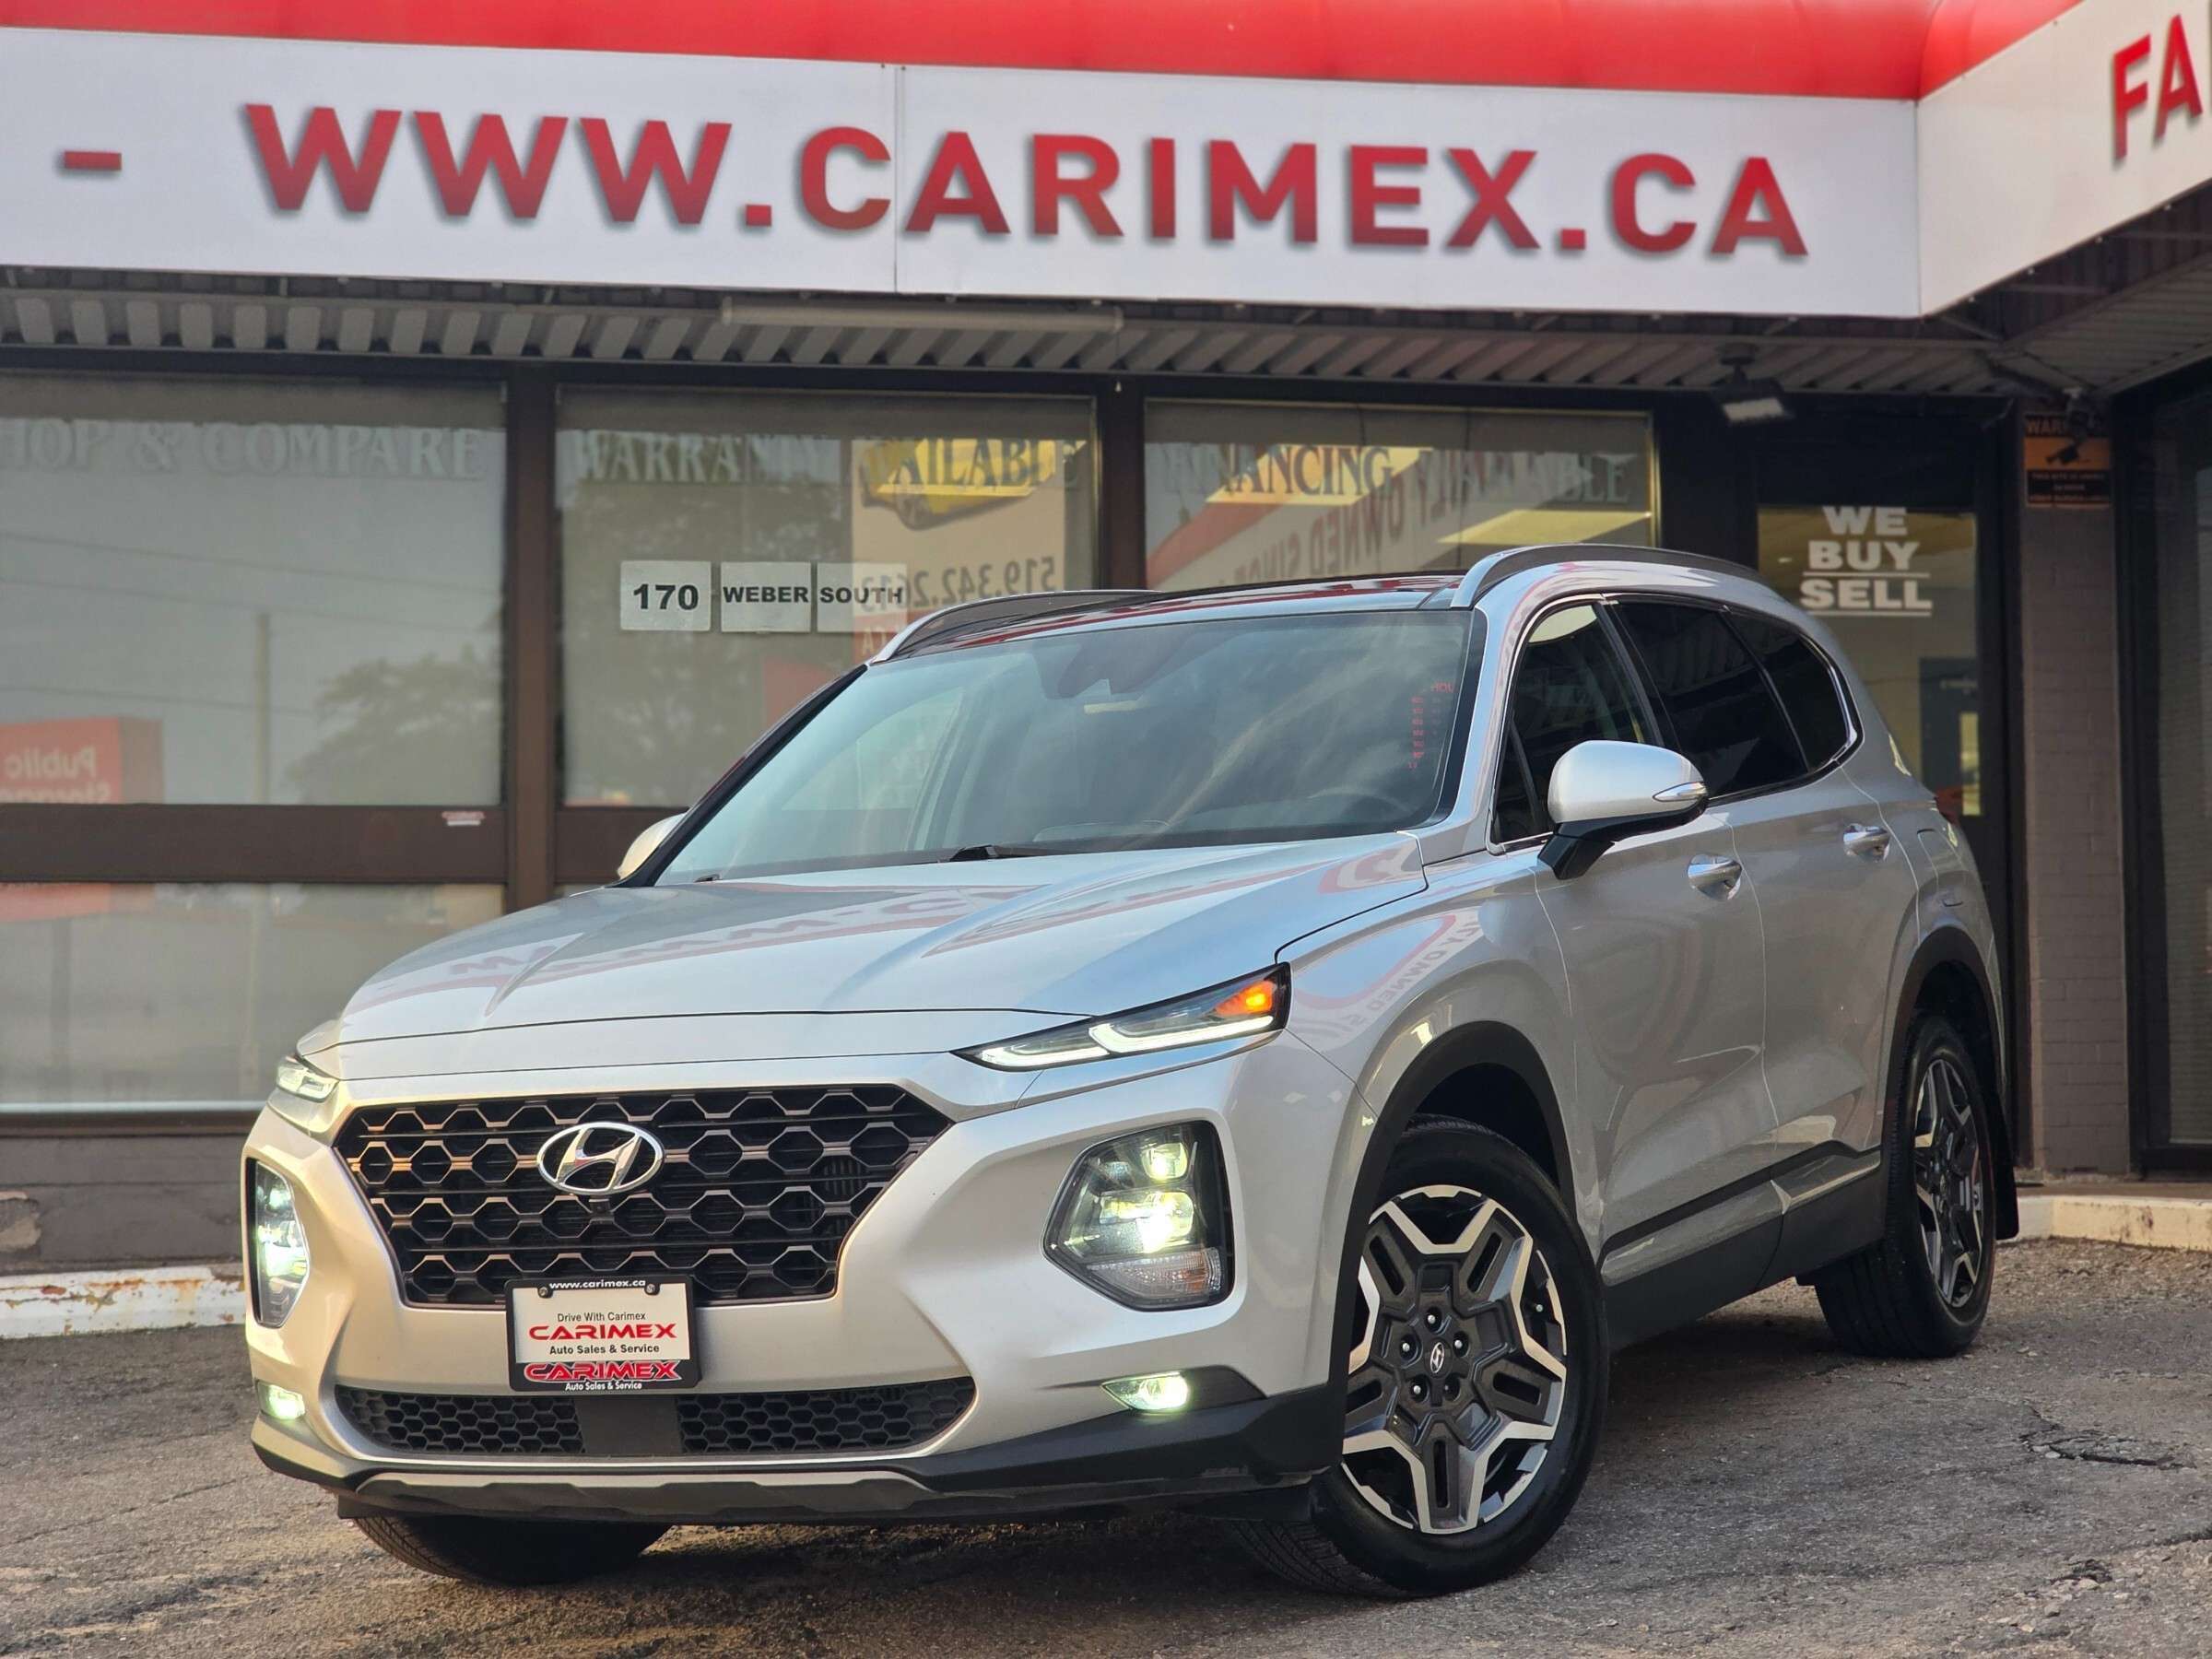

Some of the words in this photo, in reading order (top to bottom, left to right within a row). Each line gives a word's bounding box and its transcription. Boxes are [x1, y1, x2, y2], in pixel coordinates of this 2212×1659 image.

[2112, 11, 2212, 161] FA
[245, 103, 1808, 257] WWW.CARIMEX.CA
[203, 424, 486, 481] COMPARE
[1821, 506, 1908, 535] WE
[1807, 540, 1920, 571] BUY
[633, 583, 700, 611] 170
[723, 584, 810, 606] WEBER
[819, 586, 904, 606] SOUTH
[1799, 579, 1932, 610] SELL
[549, 1278, 646, 1289] www.carimex.ca
[557, 1312, 582, 1323] Drive
[583, 1312, 606, 1322] With
[607, 1312, 646, 1322] Carimex
[528, 1323, 677, 1341] CARIMEX
[549, 1345, 574, 1355] Auto
[577, 1344, 606, 1355] Sales
[609, 1344, 618, 1354] &
[620, 1343, 660, 1354] Service
[524, 1360, 682, 1382] CARIMEX
[565, 1381, 584, 1392] Auto
[585, 1381, 606, 1391] Sales
[607, 1382, 614, 1391] &
[615, 1381, 642, 1391] Service
